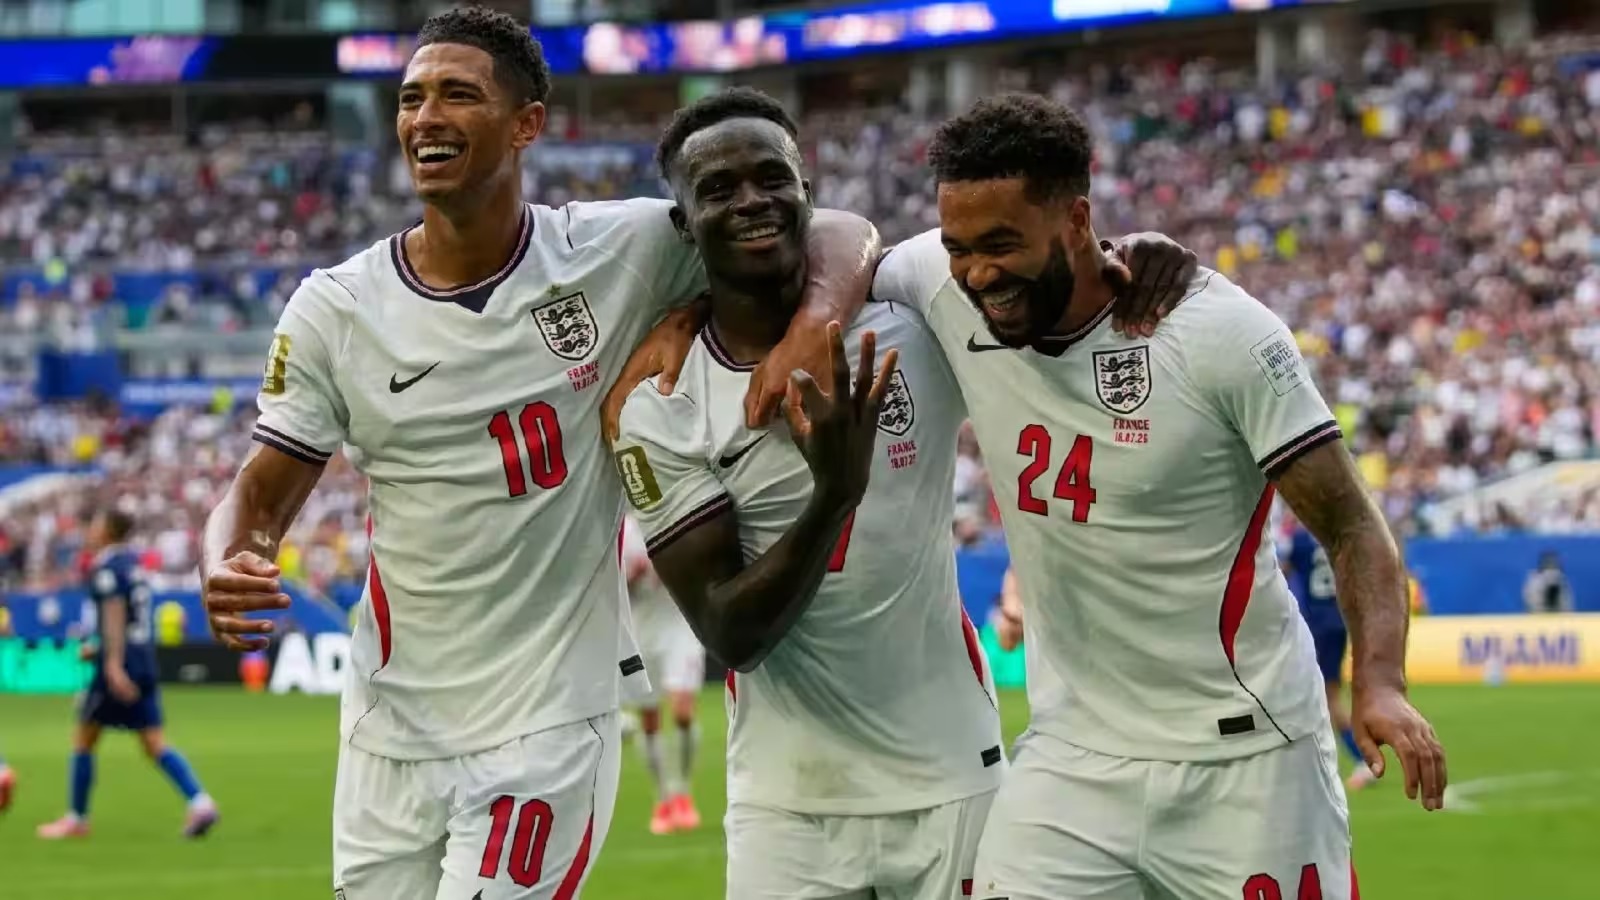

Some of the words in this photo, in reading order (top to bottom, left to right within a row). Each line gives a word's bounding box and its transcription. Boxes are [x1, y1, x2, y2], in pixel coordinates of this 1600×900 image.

[567, 360, 599, 379] FRANCE
[1265, 347, 1294, 369] UNITES
[1113, 418, 1149, 430] FRANCE
[488, 401, 568, 498] 10
[888, 440, 916, 457] FRANCE
[1017, 424, 1096, 523] 24
[1461, 633, 1579, 665] MIAMI
[479, 795, 554, 888] 10
